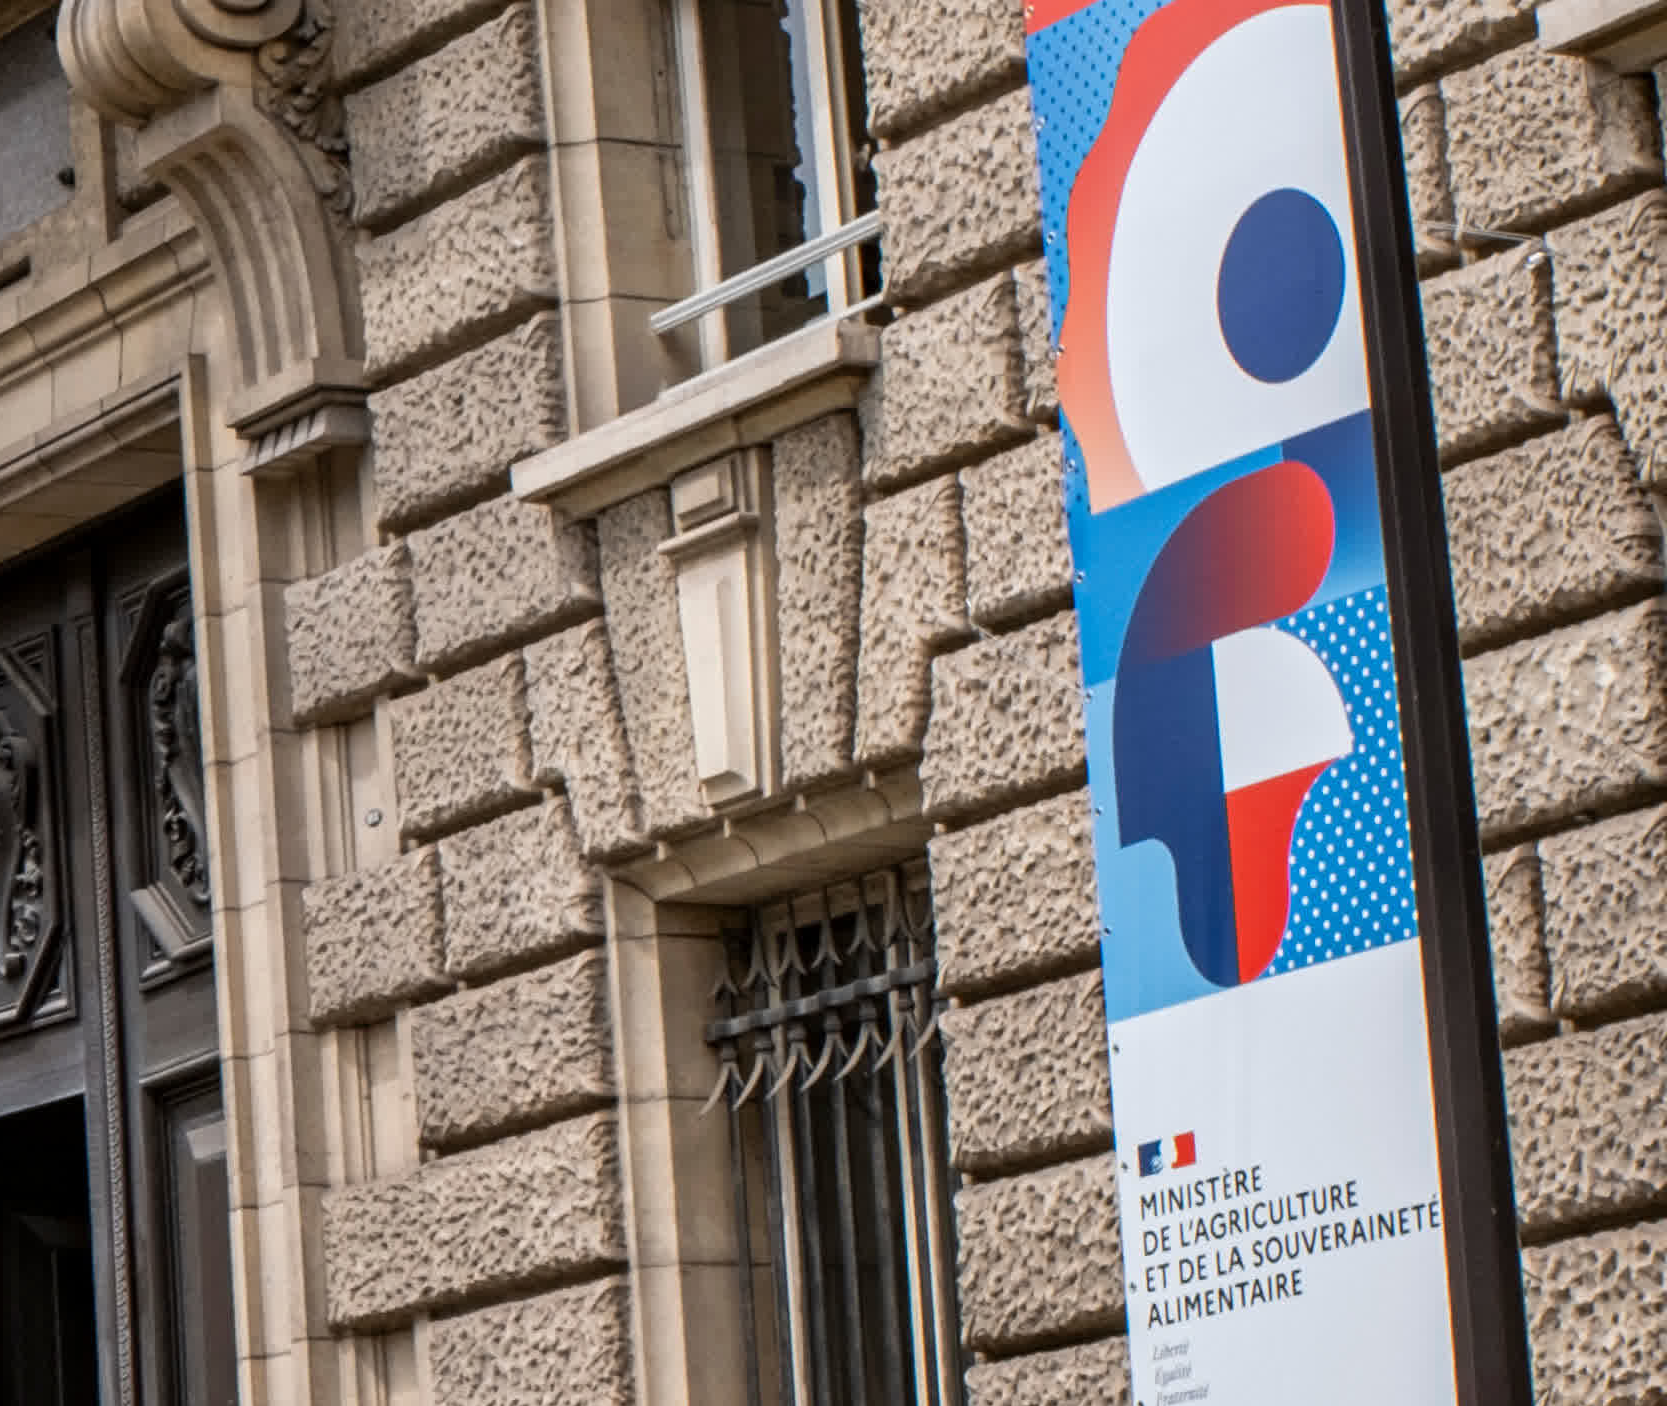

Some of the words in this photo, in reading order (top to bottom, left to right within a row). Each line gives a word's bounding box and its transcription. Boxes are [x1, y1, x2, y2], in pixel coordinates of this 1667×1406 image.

[1140, 1166, 1263, 1221] MINISTÈRE
[1143, 1225, 1171, 1256] DE
[1178, 1180, 1359, 1247] L'AGRICULTURE
[1145, 1263, 1170, 1293] ET
[1178, 1254, 1209, 1285] DE
[1215, 1249, 1245, 1277] LA
[1252, 1193, 1441, 1268] SOUVERAINETÉ
[1147, 1269, 1304, 1329] ALIMENTAIRE
